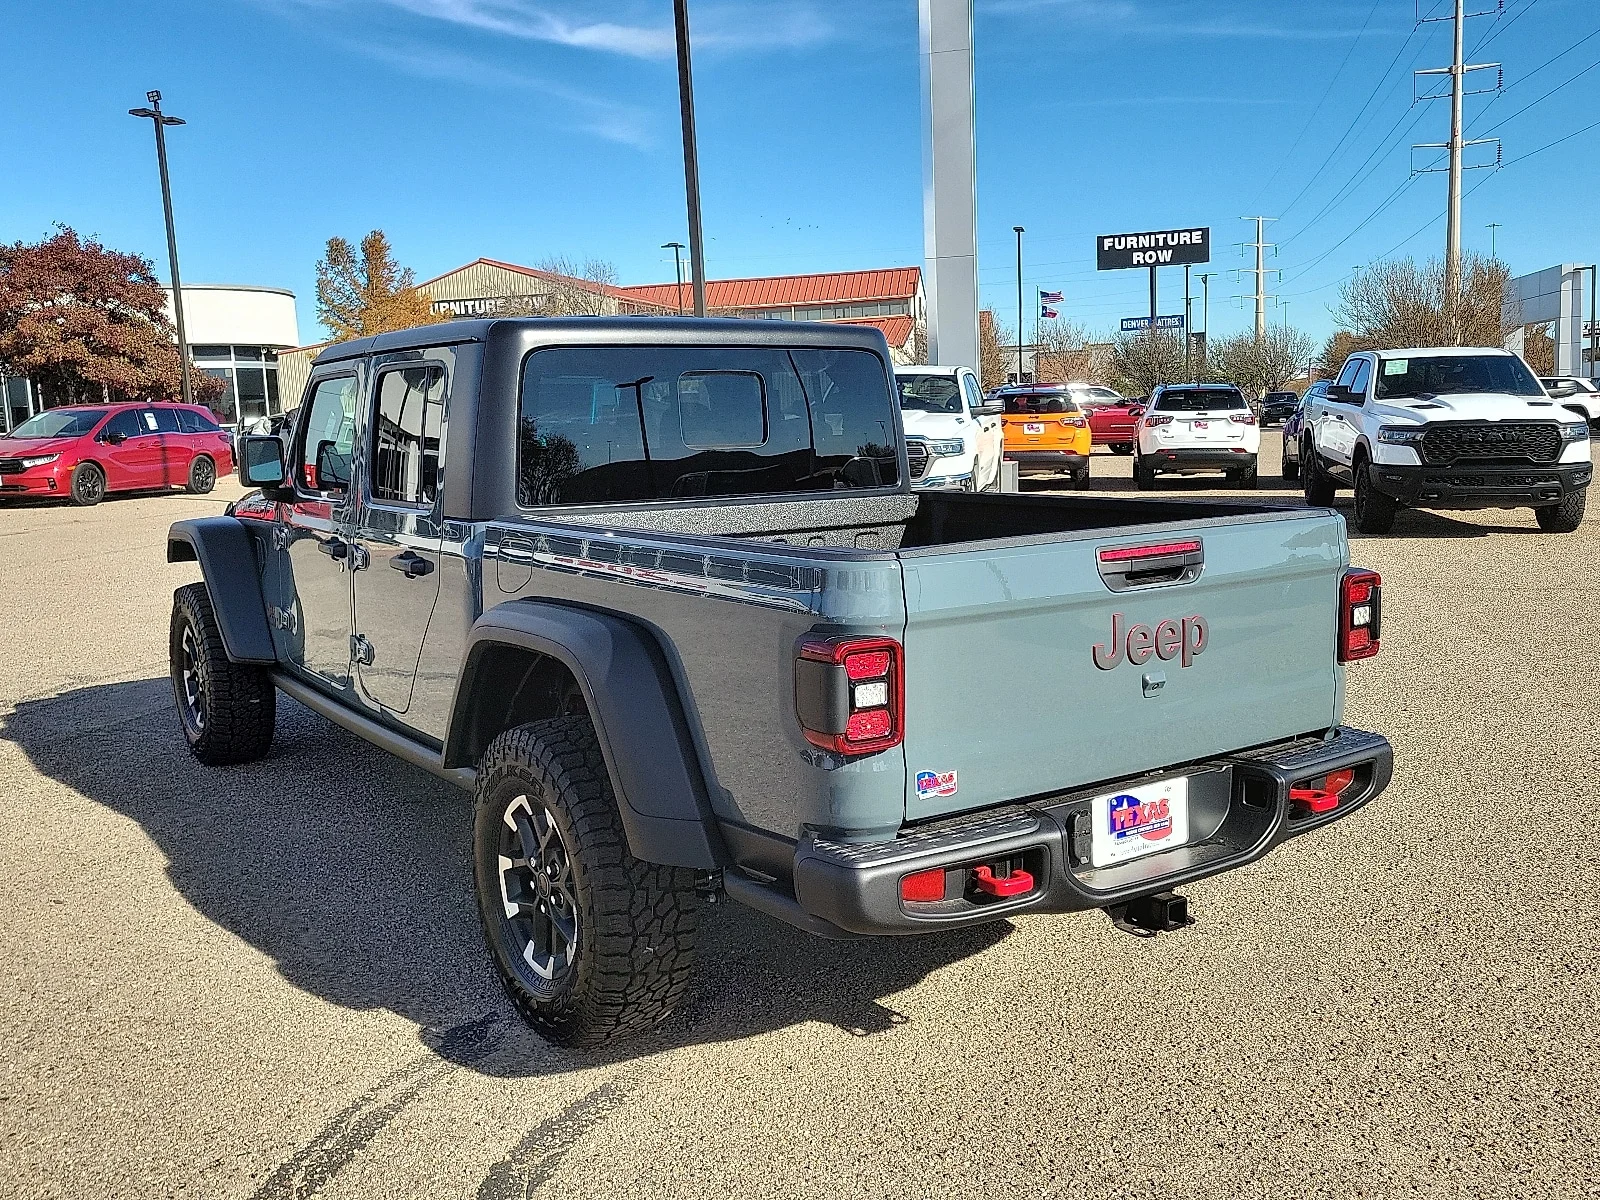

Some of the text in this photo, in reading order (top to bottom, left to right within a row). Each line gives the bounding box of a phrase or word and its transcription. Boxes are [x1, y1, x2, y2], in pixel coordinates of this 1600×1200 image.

[1103, 231, 1203, 250] FURNITURE
[1132, 250, 1173, 264] ROW
[429, 299, 505, 316] URNITURE
[1091, 613, 1209, 670] Jeep
[1112, 799, 1169, 831] TEXAS
